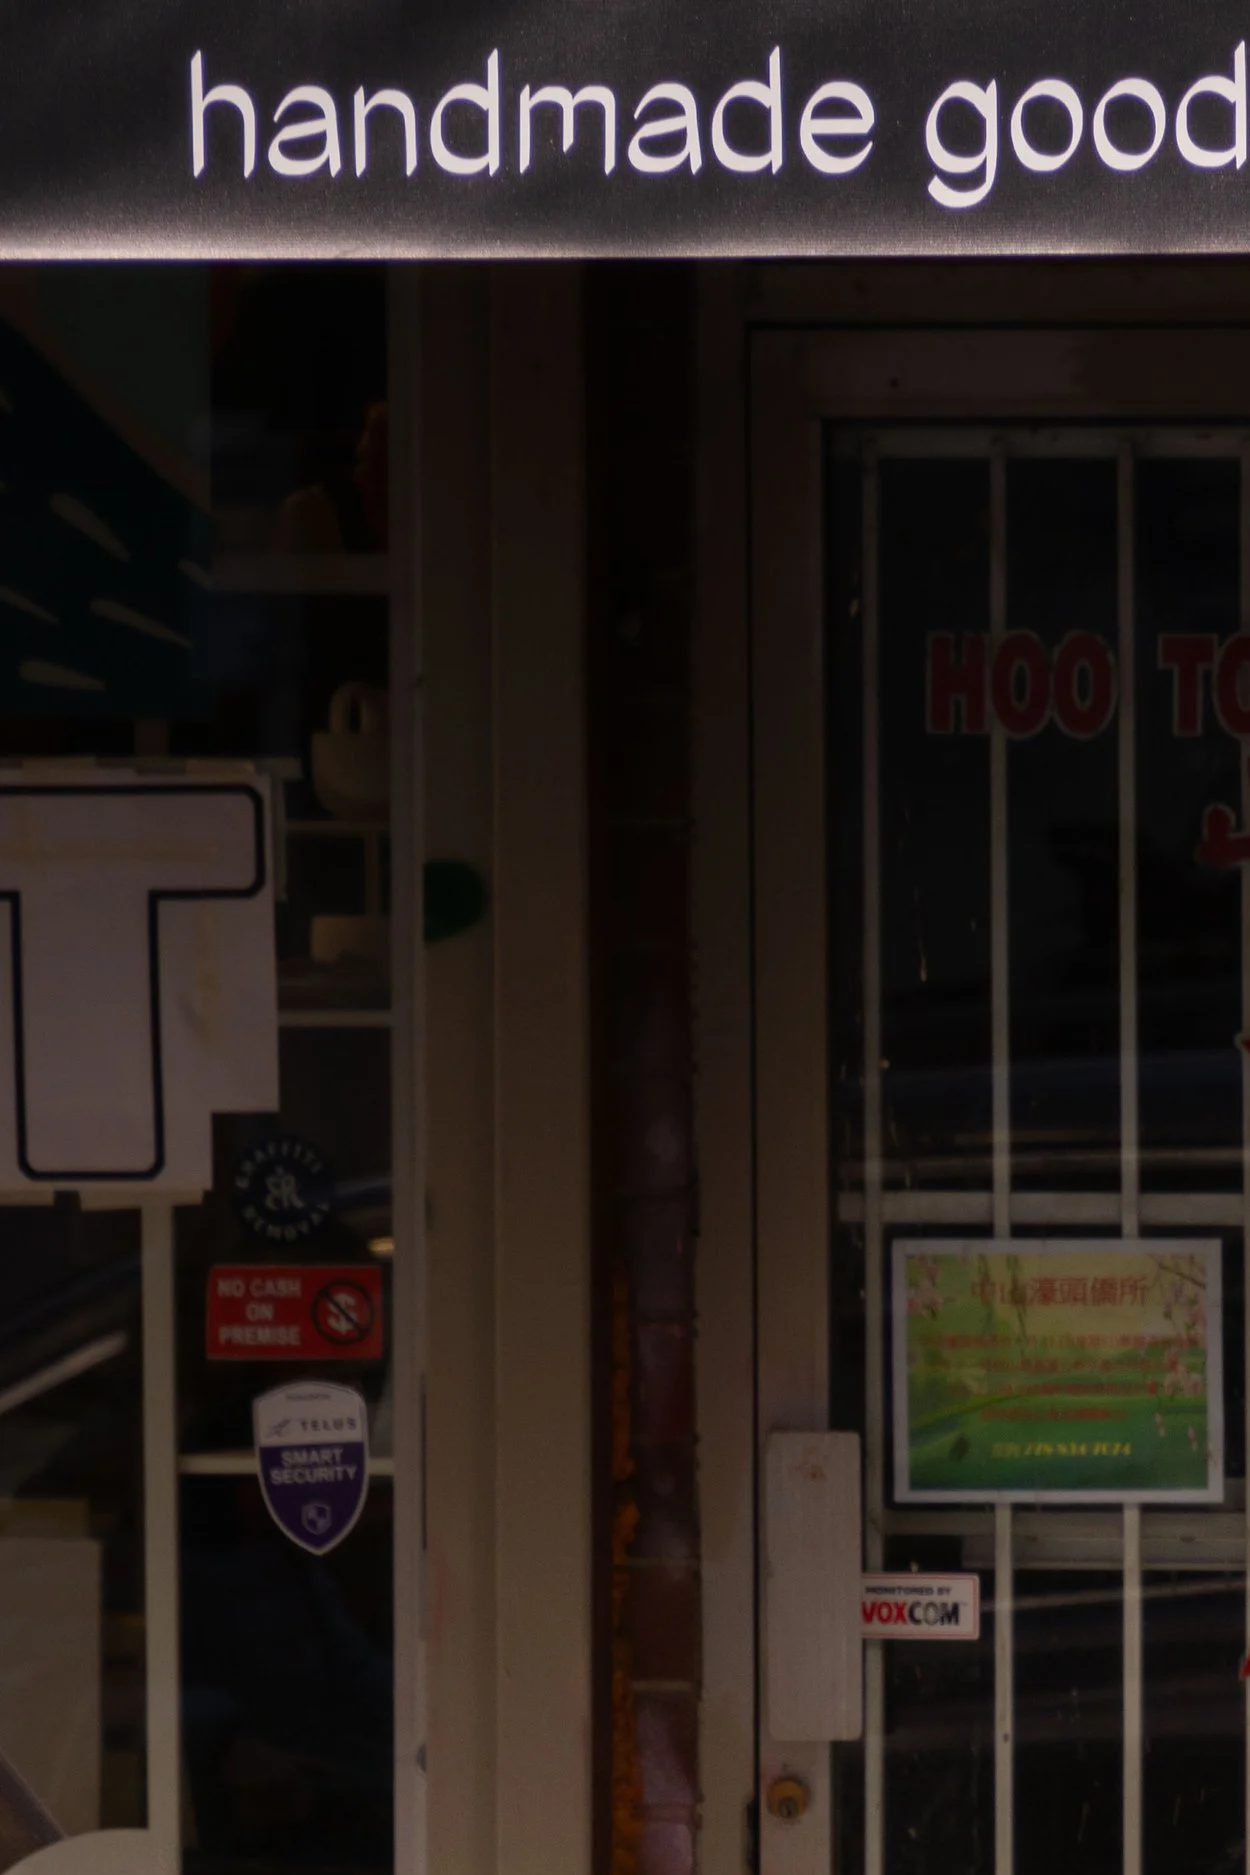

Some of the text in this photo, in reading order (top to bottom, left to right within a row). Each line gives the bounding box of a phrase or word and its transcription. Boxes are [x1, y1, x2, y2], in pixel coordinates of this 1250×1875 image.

[190, 45, 876, 179] handmade
[925, 632, 1117, 741] HOO
[217, 1278, 303, 1298] NO CASH
[245, 1301, 274, 1322] ON
[218, 1325, 302, 1347] PREMISE
[300, 1416, 358, 1432] TELUS
[280, 1447, 345, 1467] SMART
[269, 1465, 358, 1485] SECURITY
[938, 1587, 951, 1596] BY
[862, 1601, 960, 1626] VOXCOM
